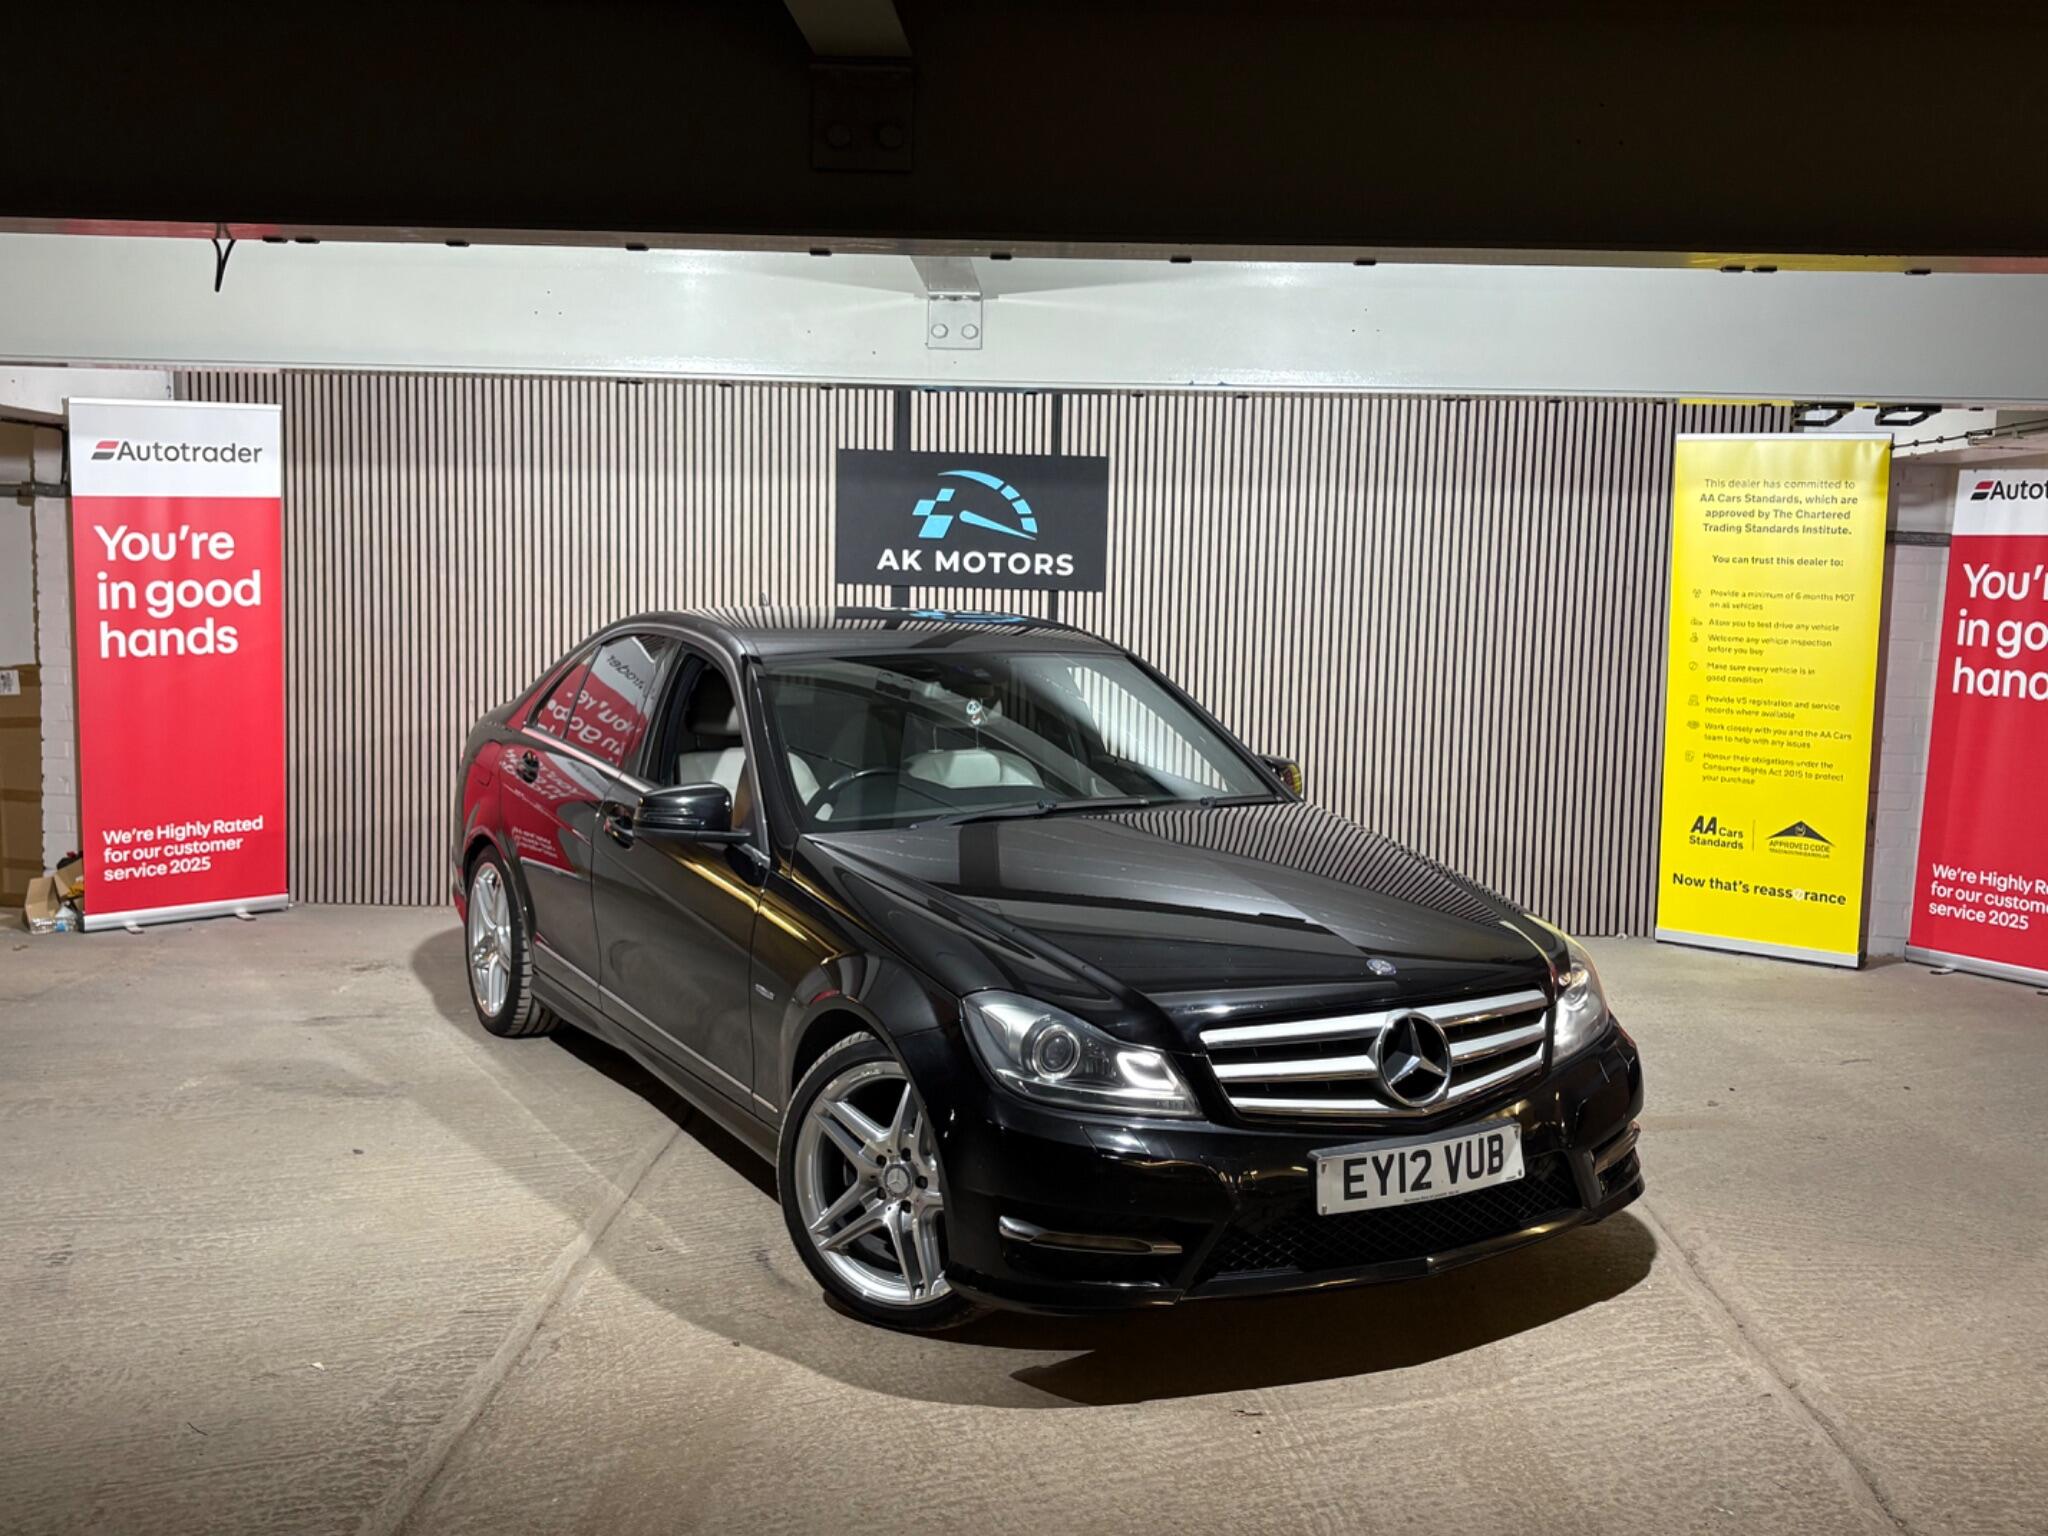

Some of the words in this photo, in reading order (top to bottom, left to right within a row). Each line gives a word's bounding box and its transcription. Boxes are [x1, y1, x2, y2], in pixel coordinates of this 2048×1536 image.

[118, 441, 262, 462] Autotrader
[1705, 479, 1726, 489] This
[1728, 479, 1760, 489] dealer
[1764, 480, 1781, 489] has
[1784, 480, 1841, 489] committed
[1845, 480, 1855, 490] to
[1700, 493, 1714, 503] AA
[1718, 494, 1742, 503] Cars
[1745, 494, 1802, 504] Standards,
[1805, 495, 1838, 504] which
[1840, 496, 1858, 504] are
[1705, 509, 1755, 519] approved
[1758, 510, 1770, 520] by
[1773, 509, 1793, 519] The
[1796, 510, 1850, 520] Chartered
[1703, 523, 1742, 534] Trading
[1745, 523, 1799, 533] Standards
[1802, 524, 1852, 535] Institute.
[94, 525, 234, 560] You're
[877, 549, 922, 571] AK
[935, 550, 1074, 576] MOTORS
[1712, 555, 1729, 563] You
[1732, 556, 1749, 564] can
[1752, 556, 1773, 565] trust
[1777, 556, 1794, 565] this
[1797, 556, 1827, 566] dealer
[1831, 558, 1844, 567] to:
[97, 571, 136, 610] in
[145, 569, 261, 618] good
[1710, 589, 1739, 597] Provide
[1786, 592, 1794, 600] of
[1795, 592, 1801, 600] 6
[1732, 620, 1745, 628] you
[1748, 620, 1755, 628] to
[1774, 621, 1793, 629] drive
[1796, 623, 1809, 631] any
[1812, 623, 1839, 631] vehicle
[1957, 609, 1990, 647] in
[100, 618, 238, 658] hands
[1708, 634, 1744, 642] Welcome
[1746, 637, 1759, 645] any
[1761, 637, 1789, 645] vehicle
[1791, 638, 1832, 647] inspection
[1708, 645, 1731, 654] before
[1750, 647, 1763, 656] buy
[1707, 662, 1727, 670] Make
[1748, 665, 1768, 674] every
[1770, 666, 1797, 674] vehicle
[1800, 667, 1806, 675] is
[1728, 674, 1763, 684] condition
[1706, 695, 1734, 704] Provide
[1736, 697, 1746, 705] V5
[1749, 698, 1793, 708] registration
[1794, 701, 1809, 709] and
[1811, 702, 1840, 711] service
[1705, 706, 1734, 715] records
[1736, 708, 1759, 717] where
[1761, 710, 1795, 720] available
[1705, 722, 1725, 731] Work
[1727, 725, 1752, 734] closely
[1755, 727, 1771, 735] with
[1773, 729, 1787, 737] you
[1789, 729, 1803, 737] and
[1805, 730, 1818, 738] the
[1820, 731, 1831, 739] AA
[1833, 732, 1852, 740] Cars
[1704, 733, 1723, 742] team
[1725, 735, 1732, 743] to
[1734, 736, 1750, 745] help
[1753, 737, 1769, 745] with
[1771, 739, 1784, 748] any
[1786, 740, 1811, 749] issues
[1733, 754, 1750, 762] their
[1796, 760, 1819, 769] under
[1821, 761, 1833, 769] the
[1702, 774, 1718, 782] your
[1721, 775, 1755, 785] purchase
[1703, 762, 1741, 772] Consumer
[1743, 766, 1766, 776] Rights
[1768, 768, 1782, 777] Act
[1784, 769, 1803, 778] 2015
[1805, 771, 1813, 779] to
[1815, 772, 1844, 783] protect
[103, 828, 154, 845] We're
[157, 823, 211, 841] Highly
[213, 815, 263, 833] Rated
[1691, 815, 1717, 835] AA
[1719, 827, 1743, 838] Cars
[104, 848, 129, 864] for
[133, 846, 161, 860] our
[164, 837, 243, 857] customer
[1689, 835, 1743, 850] Standards
[104, 862, 167, 881] service
[170, 857, 211, 874] 2025
[1673, 873, 1705, 887] Now
[1709, 877, 1750, 893] that's
[1933, 863, 1976, 884] We're
[1980, 871, 2032, 895] Highly
[1931, 881, 1953, 898] for
[1956, 888, 1982, 903] our
[1929, 902, 1986, 922] service
[1989, 910, 2029, 930] 2025
[1343, 1150, 1432, 1200] EY12
[1444, 1134, 1503, 1184] VUB
